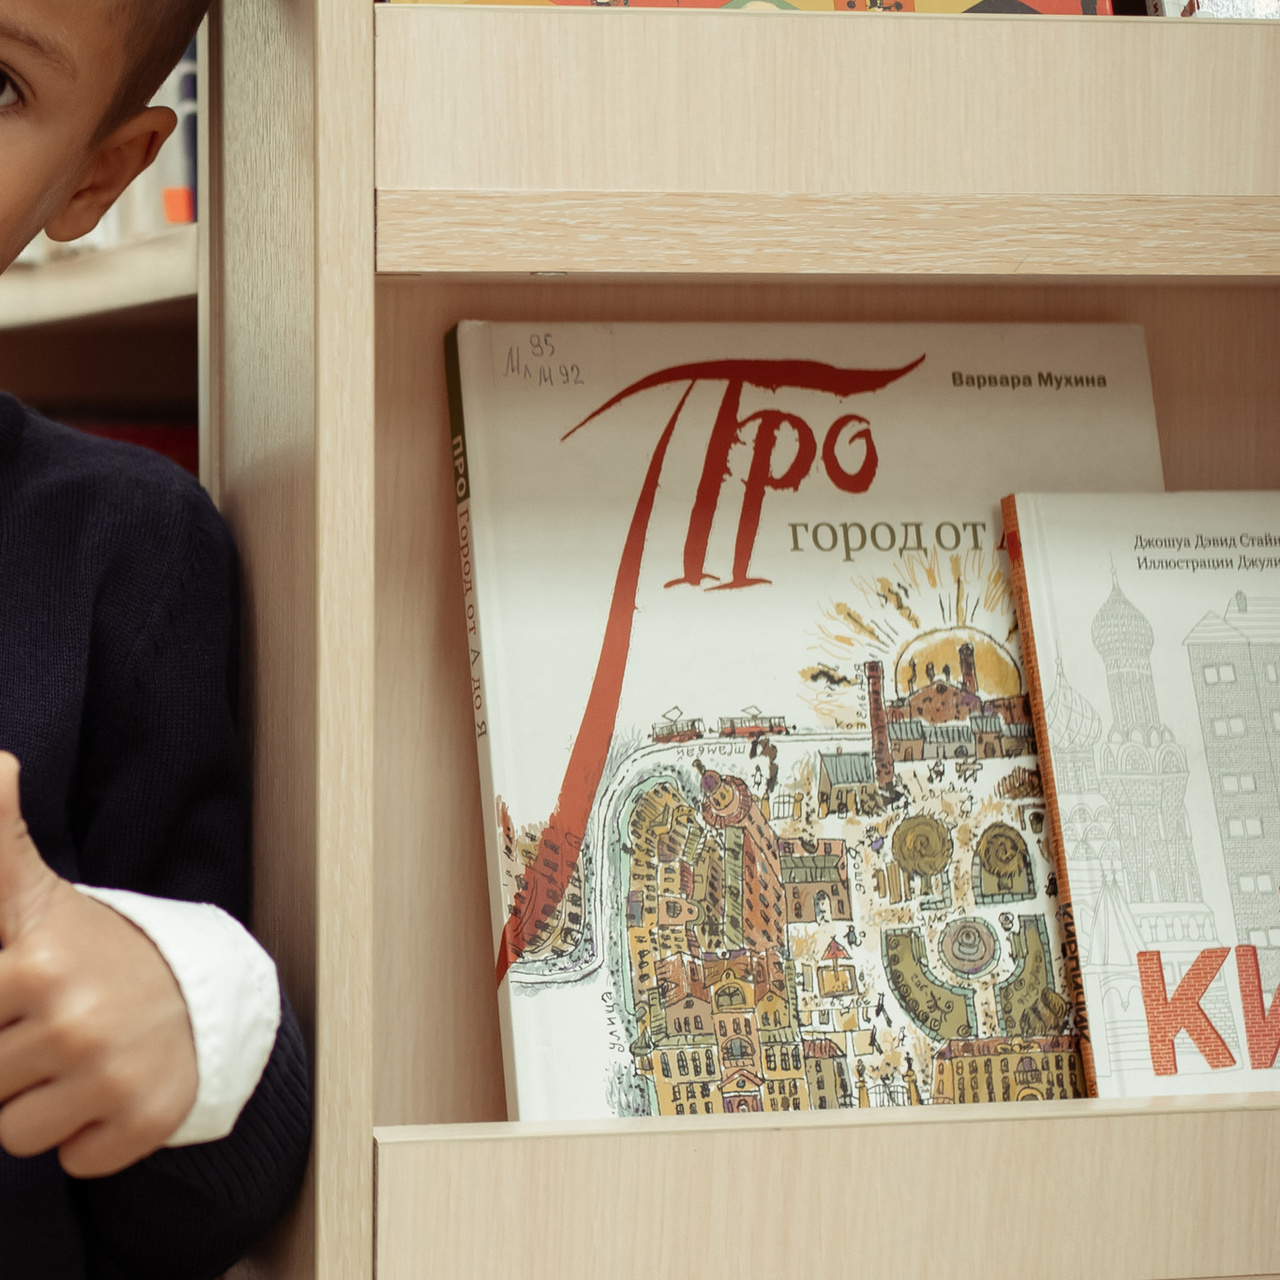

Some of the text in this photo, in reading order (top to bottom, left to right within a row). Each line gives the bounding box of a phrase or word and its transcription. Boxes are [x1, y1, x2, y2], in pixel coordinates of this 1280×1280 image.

[951, 370, 1108, 391] Варвара Мухина
[451, 435, 467, 499] ПРО
[789, 521, 927, 562] город
[936, 523, 987, 551] от
[1134, 534, 1191, 551] Джошуа
[1195, 533, 1237, 550] Дэвид
[1137, 556, 1234, 573] Иллюстрации
[466, 607, 477, 637] от
[471, 677, 482, 710] до
[476, 719, 487, 739] Я
[601, 991, 624, 1053] улица
